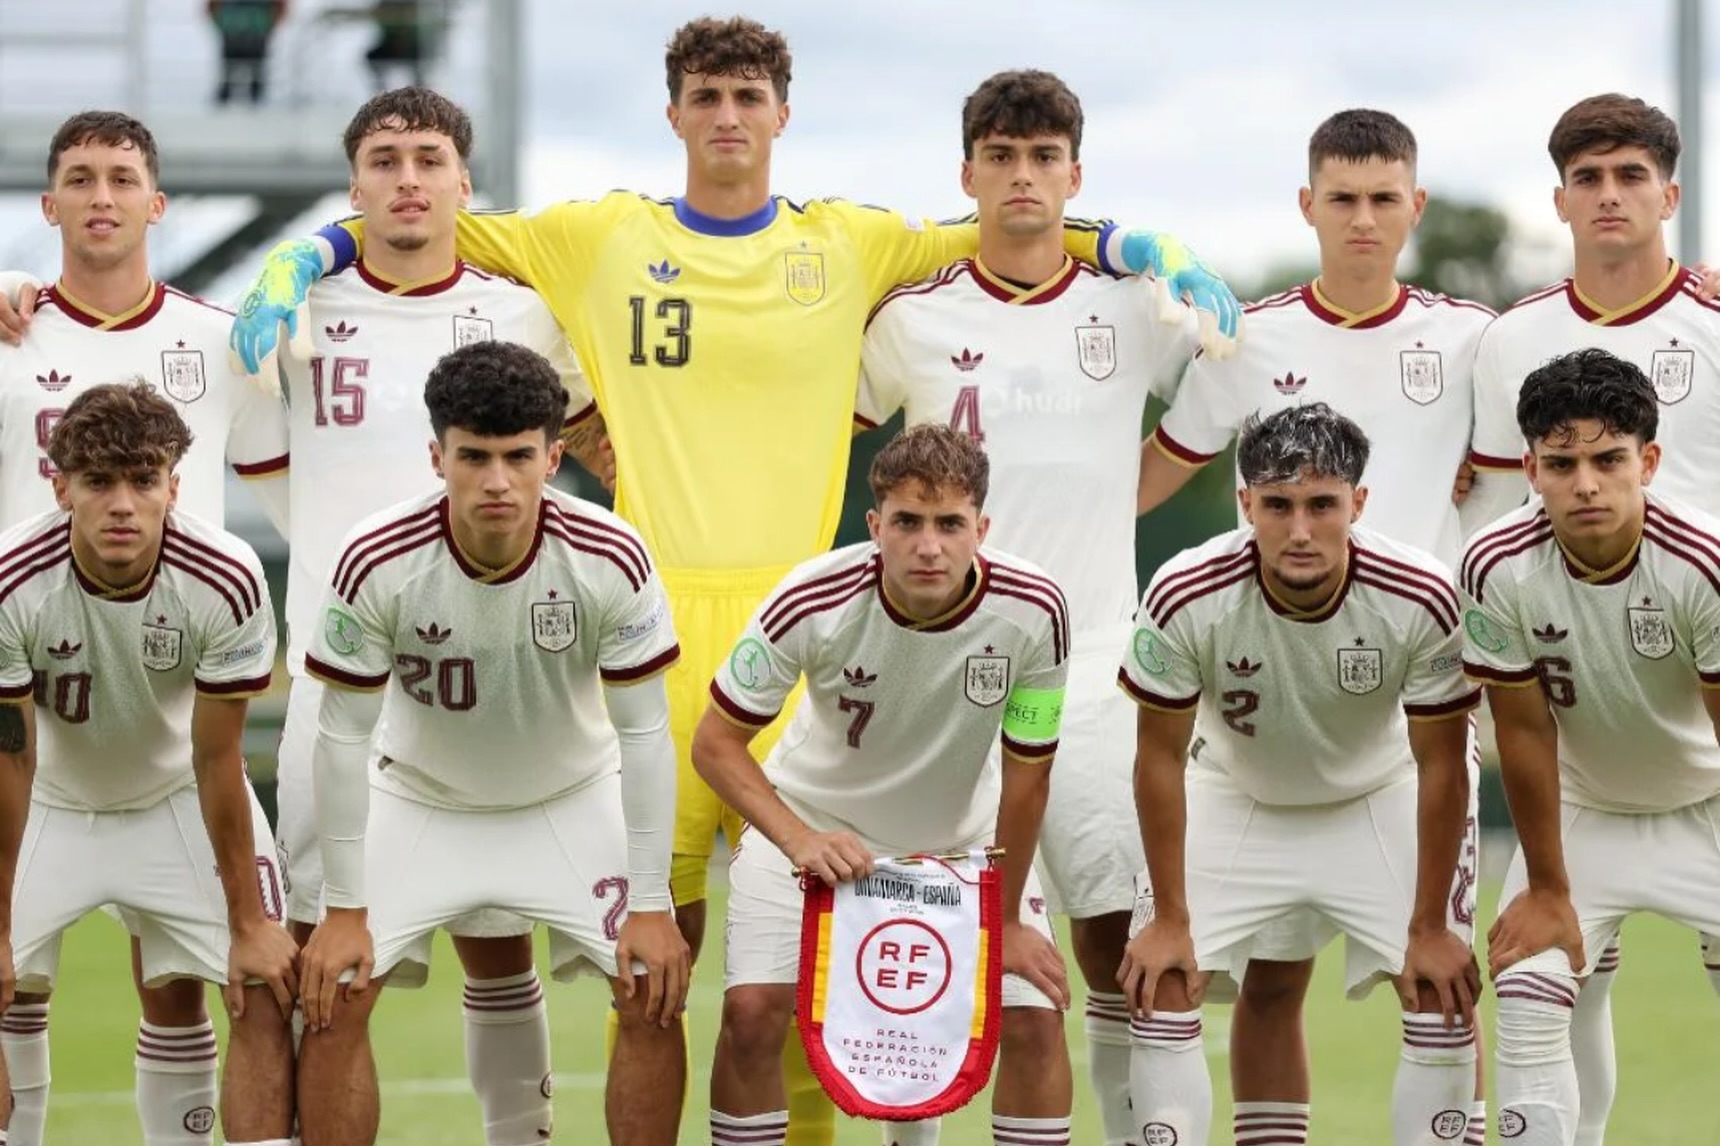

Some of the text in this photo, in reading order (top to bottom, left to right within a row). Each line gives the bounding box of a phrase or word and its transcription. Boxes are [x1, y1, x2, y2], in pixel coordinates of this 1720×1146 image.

[629, 296, 692, 367] 13
[310, 356, 369, 427] 15
[951, 385, 986, 442] 4
[396, 653, 477, 711] 20
[1534, 656, 1577, 708] 6
[838, 694, 875, 749] 7
[1222, 690, 1260, 737] 2
[843, 1038, 948, 1056] FEDERACIÓN
[877, 1029, 918, 1040] REAL
[848, 1066, 867, 1074] DE
[851, 1053, 938, 1068] ESPAÑOLA
[877, 1067, 938, 1082] FÚTBOL
